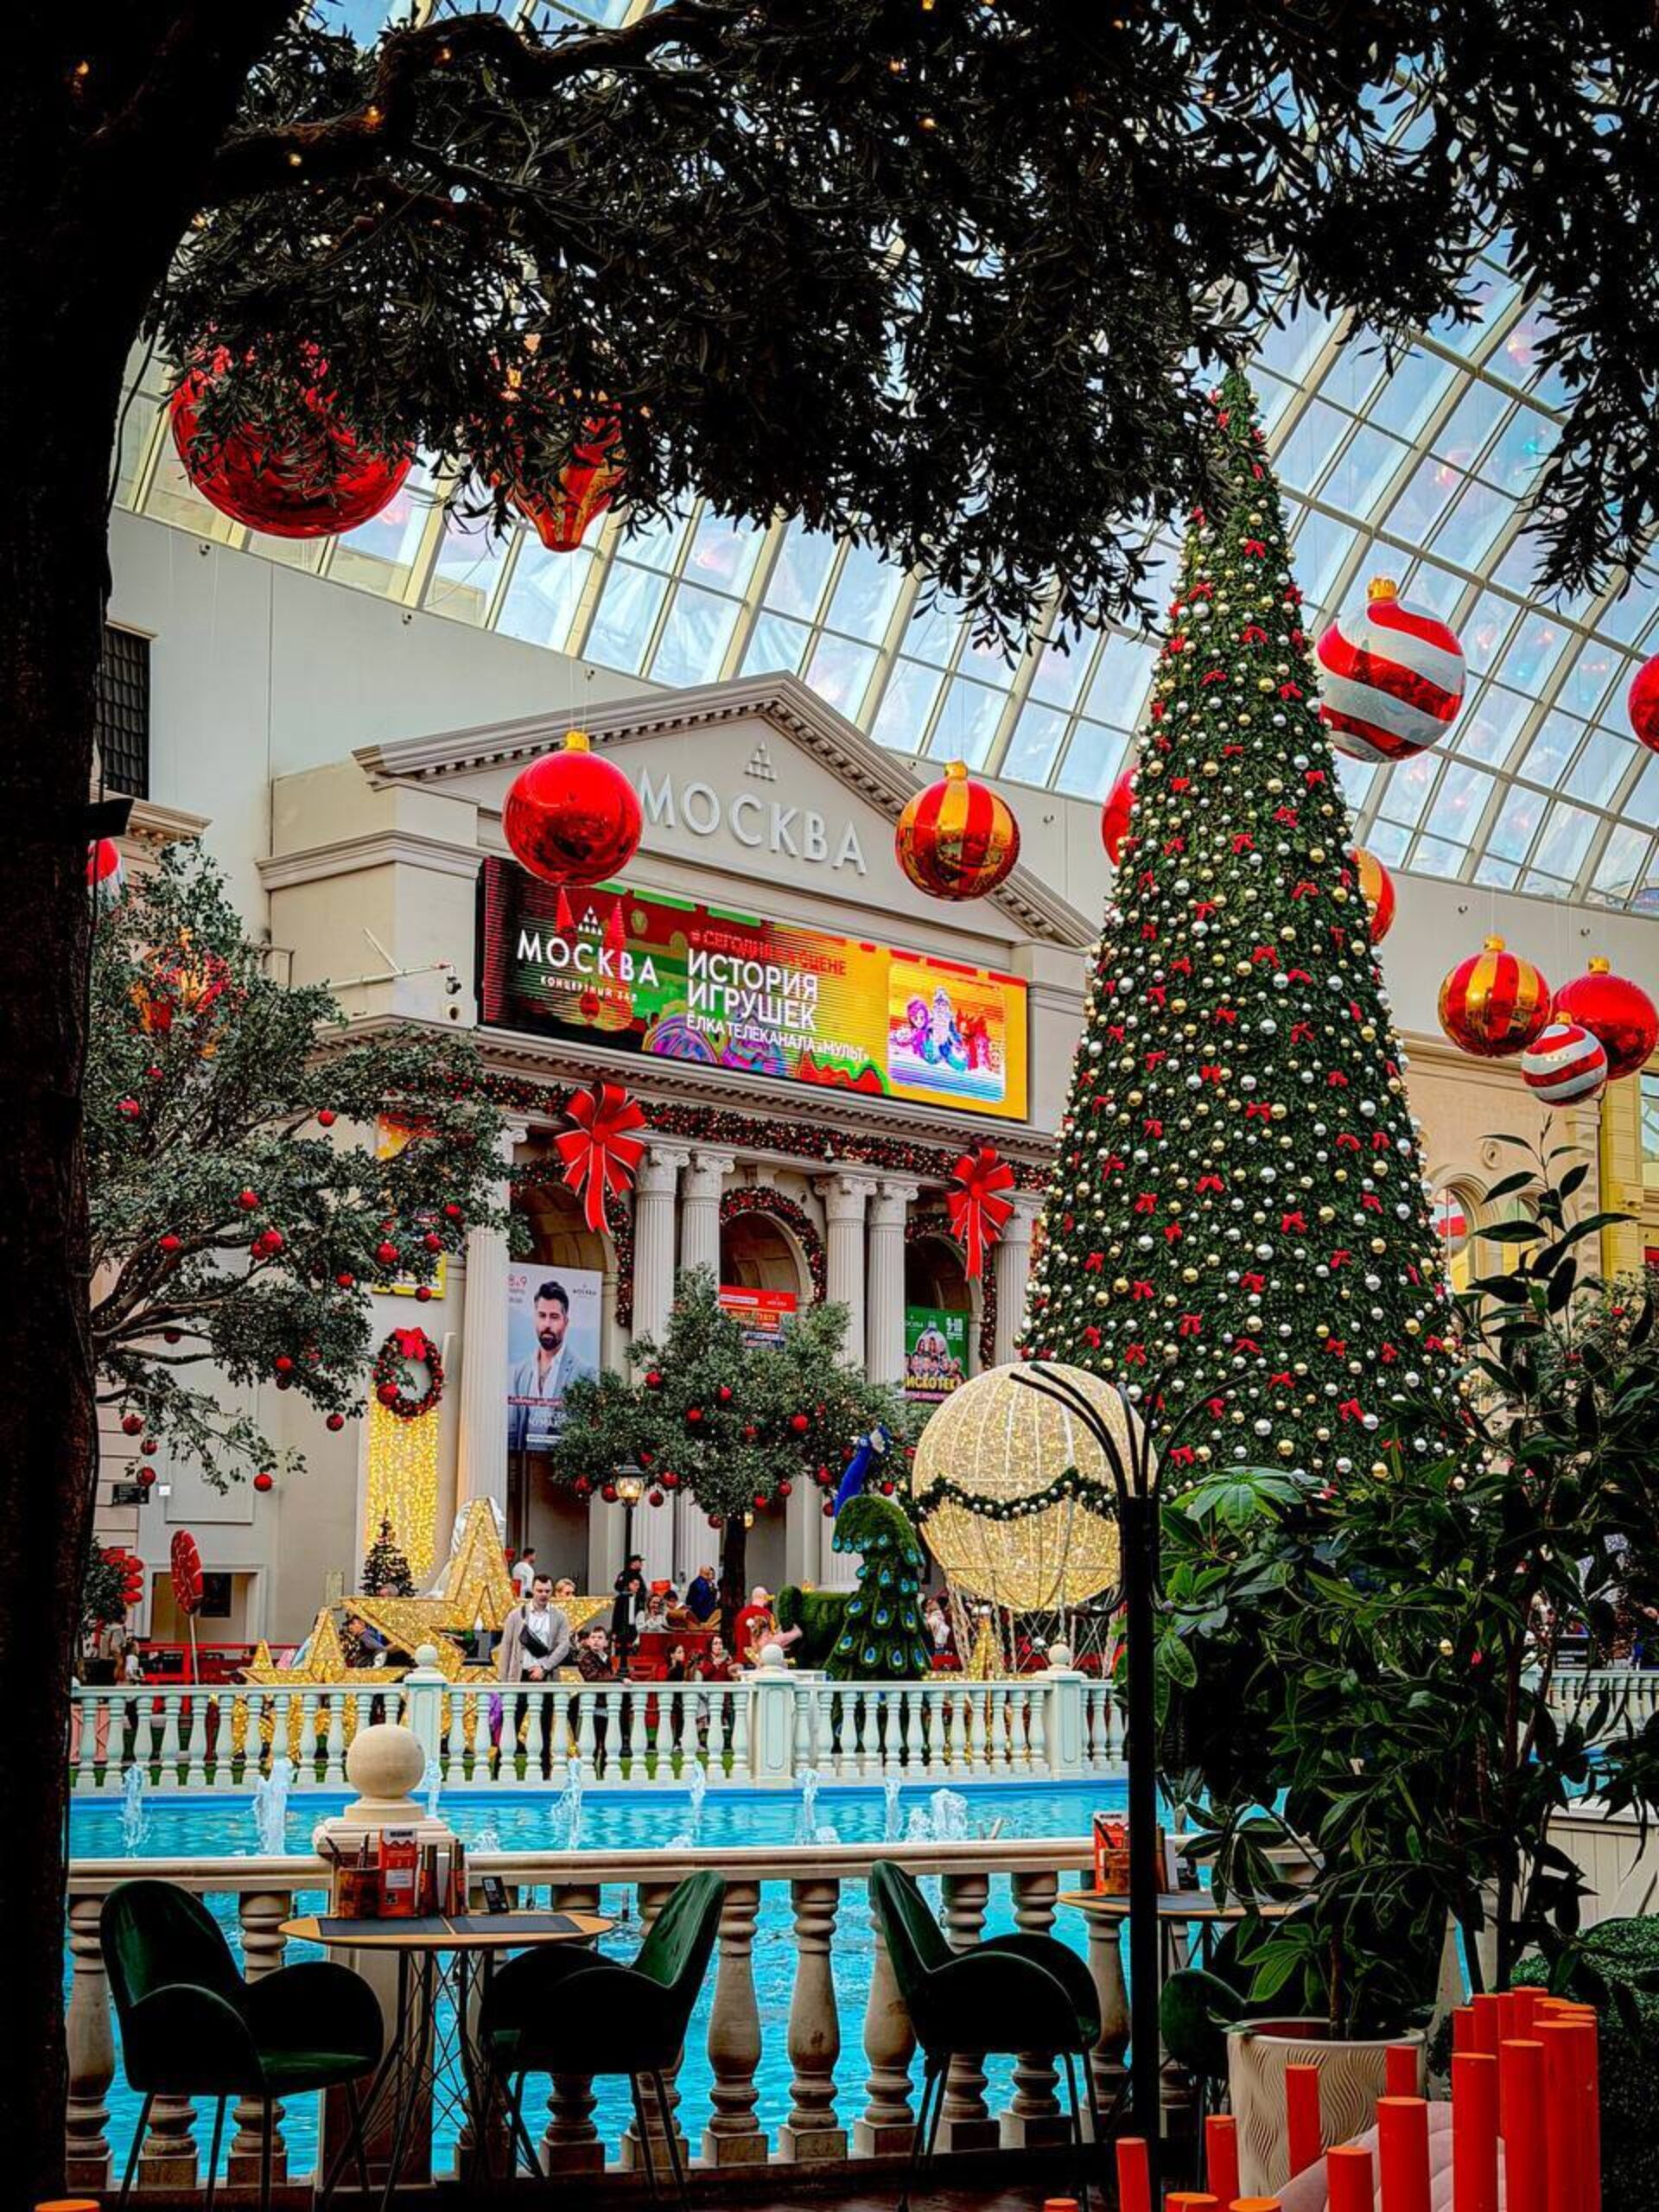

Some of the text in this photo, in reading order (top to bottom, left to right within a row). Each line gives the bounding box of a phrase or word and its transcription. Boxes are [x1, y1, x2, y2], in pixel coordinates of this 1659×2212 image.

[639, 766, 868, 876] МОСКВА
[516, 929, 659, 988] МОСКВА
[688, 947, 818, 1001] ИСТОРИЯ
[686, 1009, 725, 1036] ЁЛКА
[727, 1020, 814, 1052] ТЕЛЕКАНАЛА
[688, 979, 817, 1032] ИГРУШЕК
